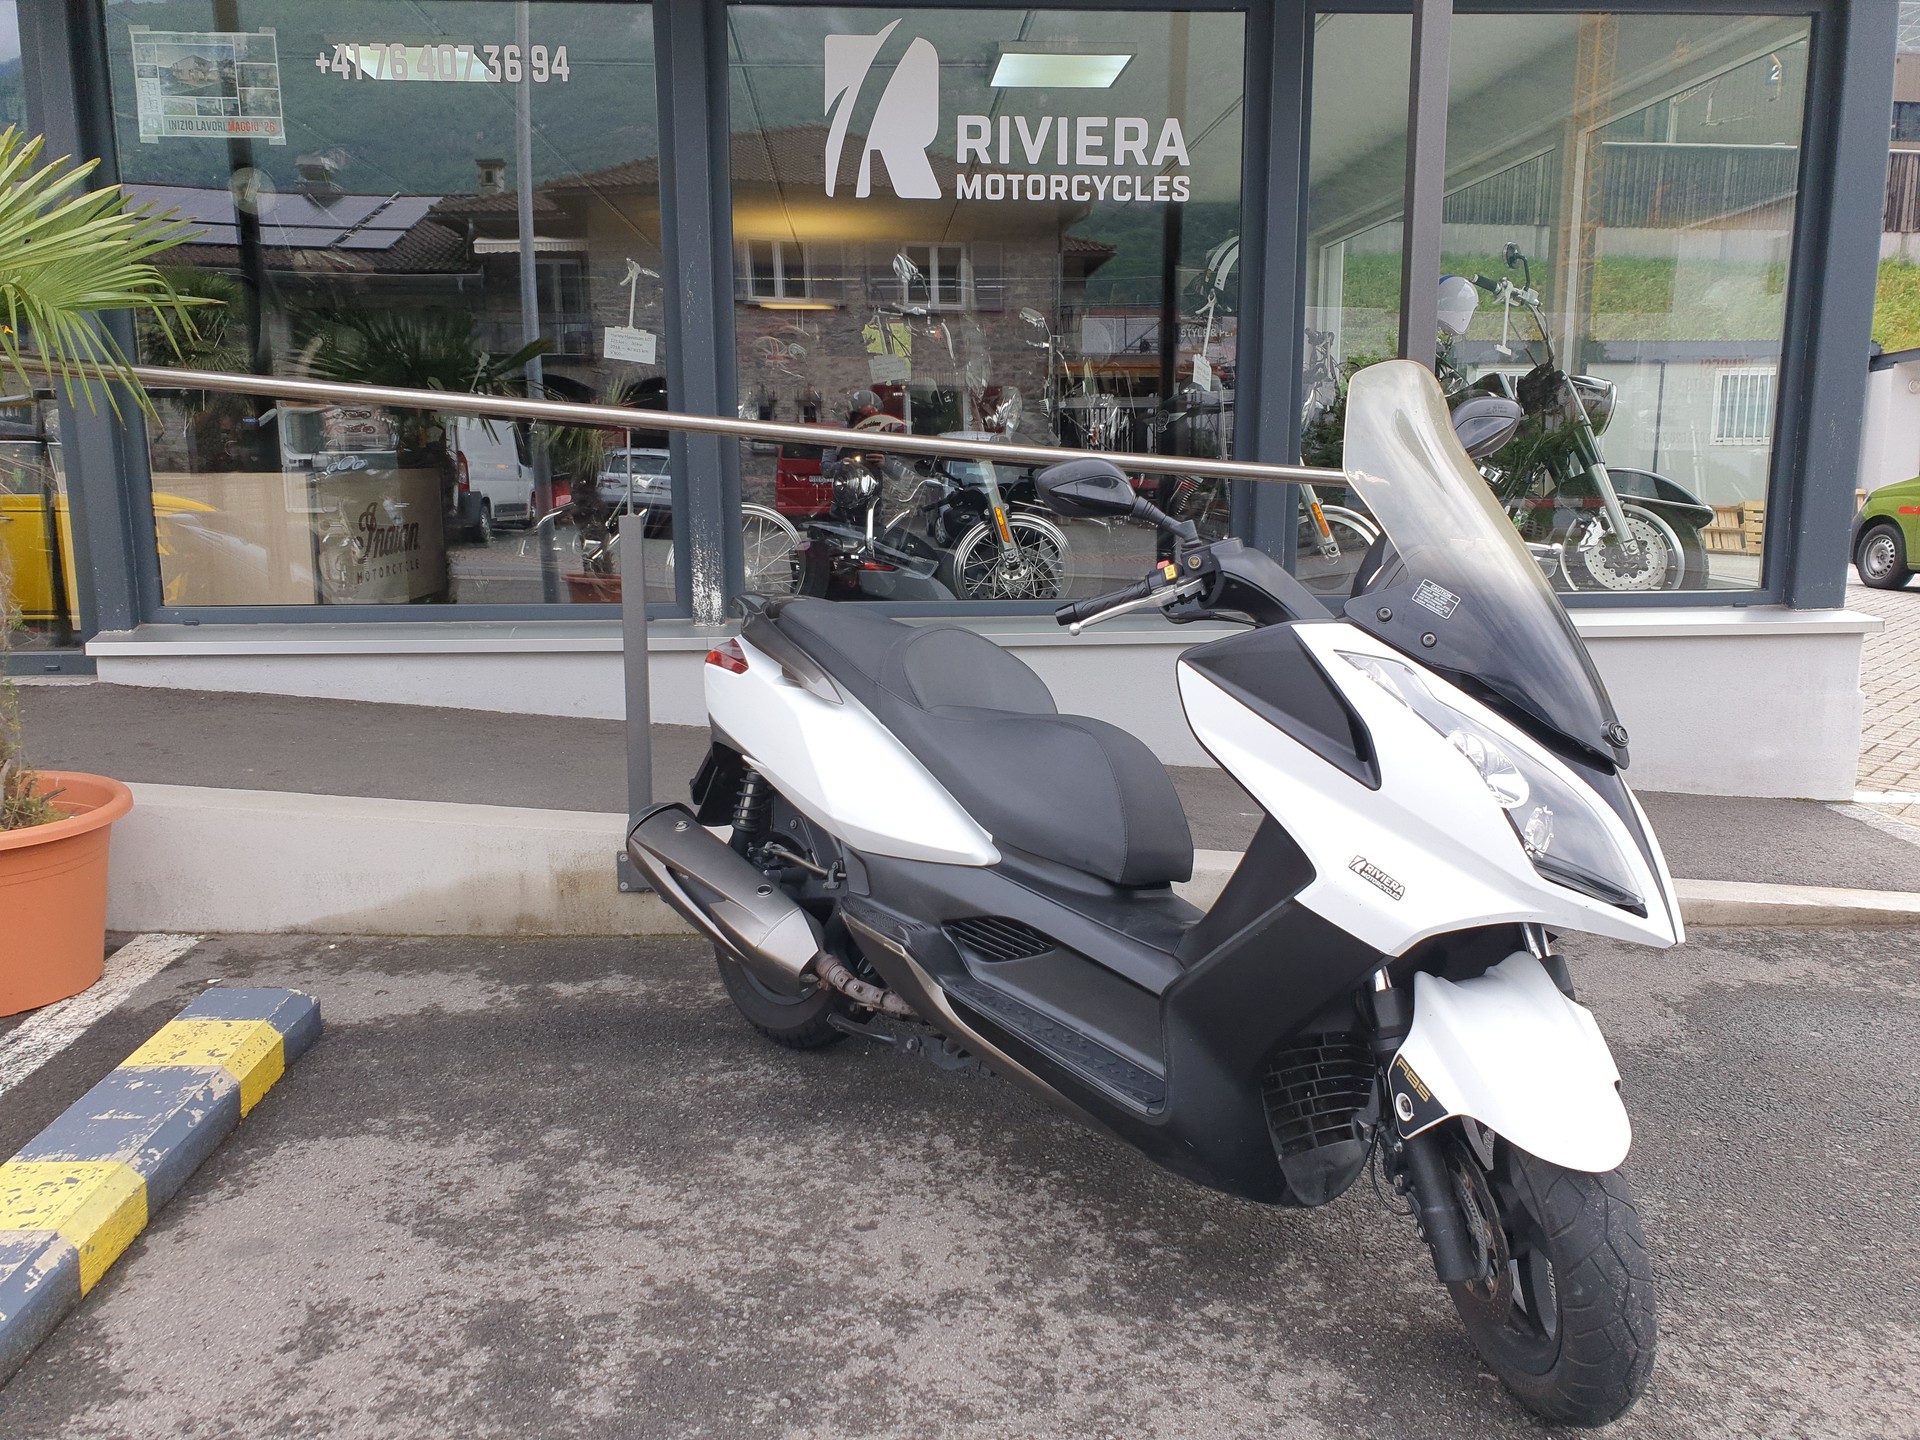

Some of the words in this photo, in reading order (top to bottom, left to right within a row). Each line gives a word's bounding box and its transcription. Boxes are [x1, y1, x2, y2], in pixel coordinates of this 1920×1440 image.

[315, 43, 362, 80] +41
[370, 43, 408, 81] 76
[417, 44, 475, 81] 407
[483, 44, 522, 82] 36
[531, 45, 570, 82] 94
[168, 119, 194, 131] INIZIO
[196, 120, 226, 131] LAVORI
[956, 115, 1190, 166] RIVIERA
[956, 173, 1190, 202] MOTORCYCLES
[1364, 863, 1405, 895] RIVIERA
[1397, 1058, 1431, 1103] ABS
